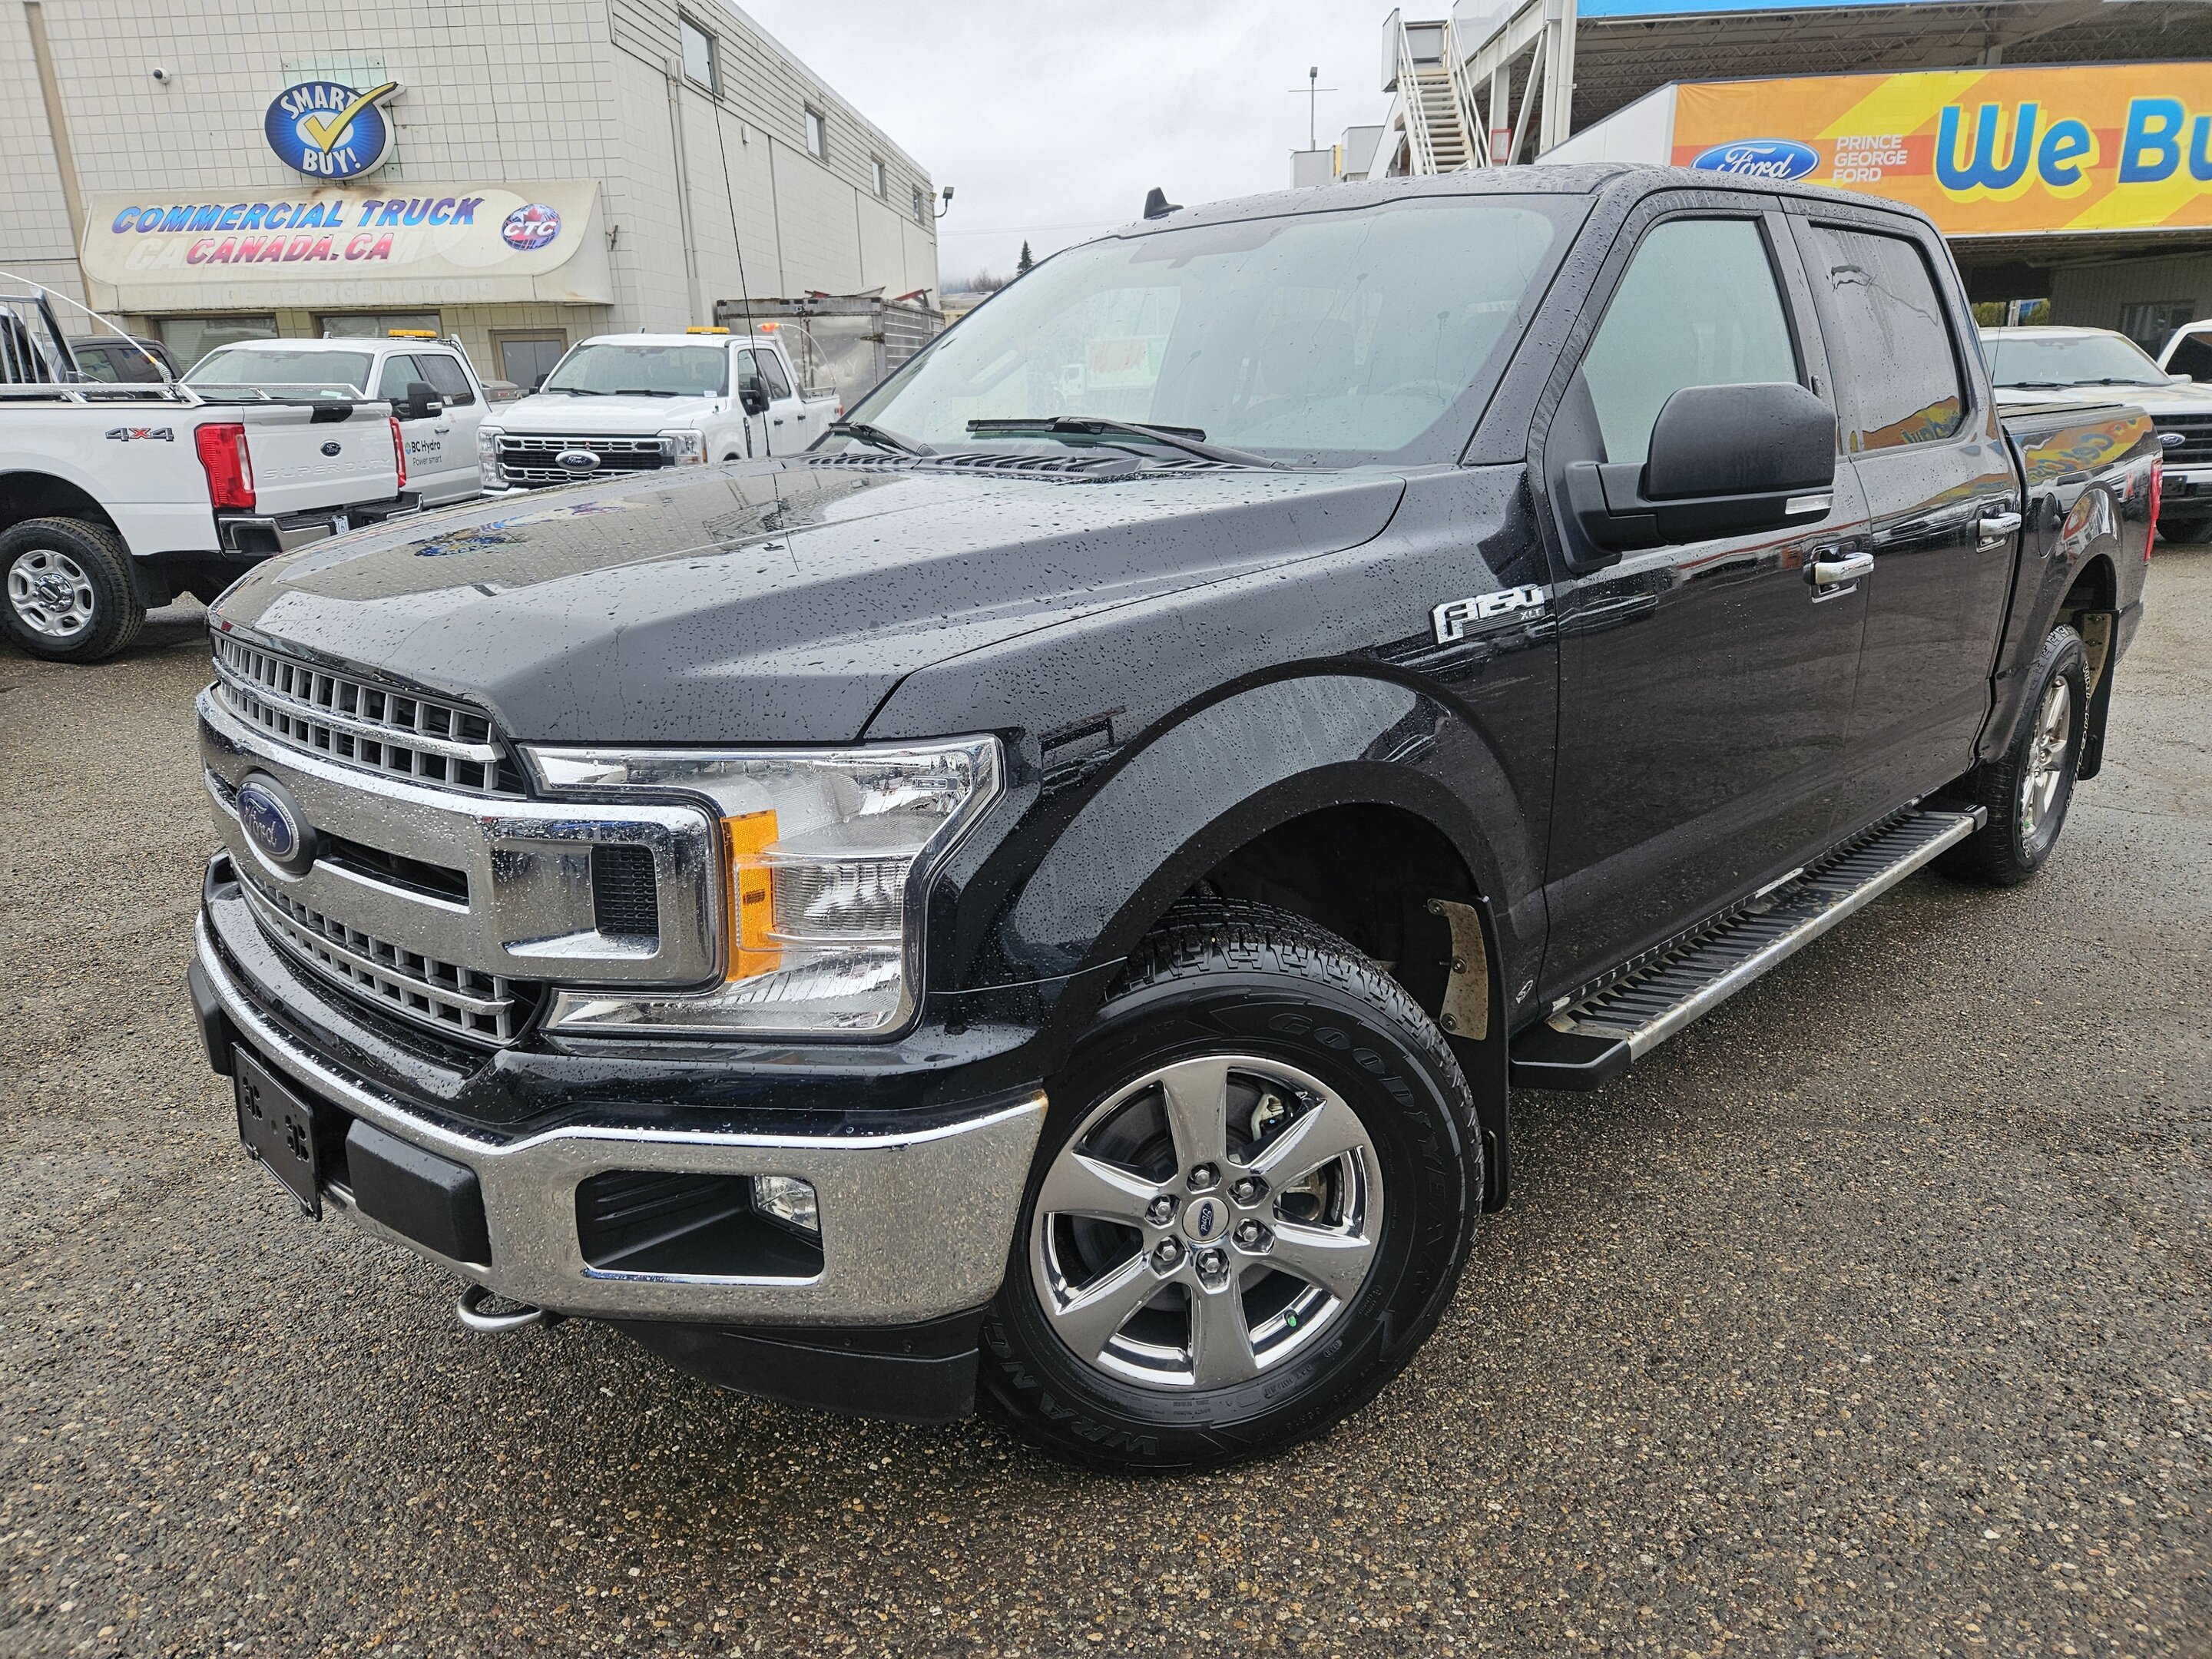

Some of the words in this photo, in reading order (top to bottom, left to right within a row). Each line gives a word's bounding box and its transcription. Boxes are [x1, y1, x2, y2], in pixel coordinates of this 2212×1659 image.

[280, 85, 360, 120] SMART
[1836, 134, 1903, 151] PRINCE
[1935, 101, 2092, 192] We
[302, 147, 361, 175] BUY!
[1717, 146, 1796, 178] Ford
[1834, 150, 1908, 167] GEORGE
[1832, 167, 1882, 184] FORD
[111, 200, 344, 234] COMMERCIAL
[357, 197, 485, 227] TRUCK
[503, 220, 557, 237] CTC
[186, 233, 395, 265] CANADA.CA
[411, 441, 420, 452] BC
[421, 439, 441, 453] Hydro
[412, 457, 428, 466] Power
[1519, 608, 1541, 621] XLT
[243, 797, 278, 848] Ford
[1200, 1207, 1212, 1231] Ford
